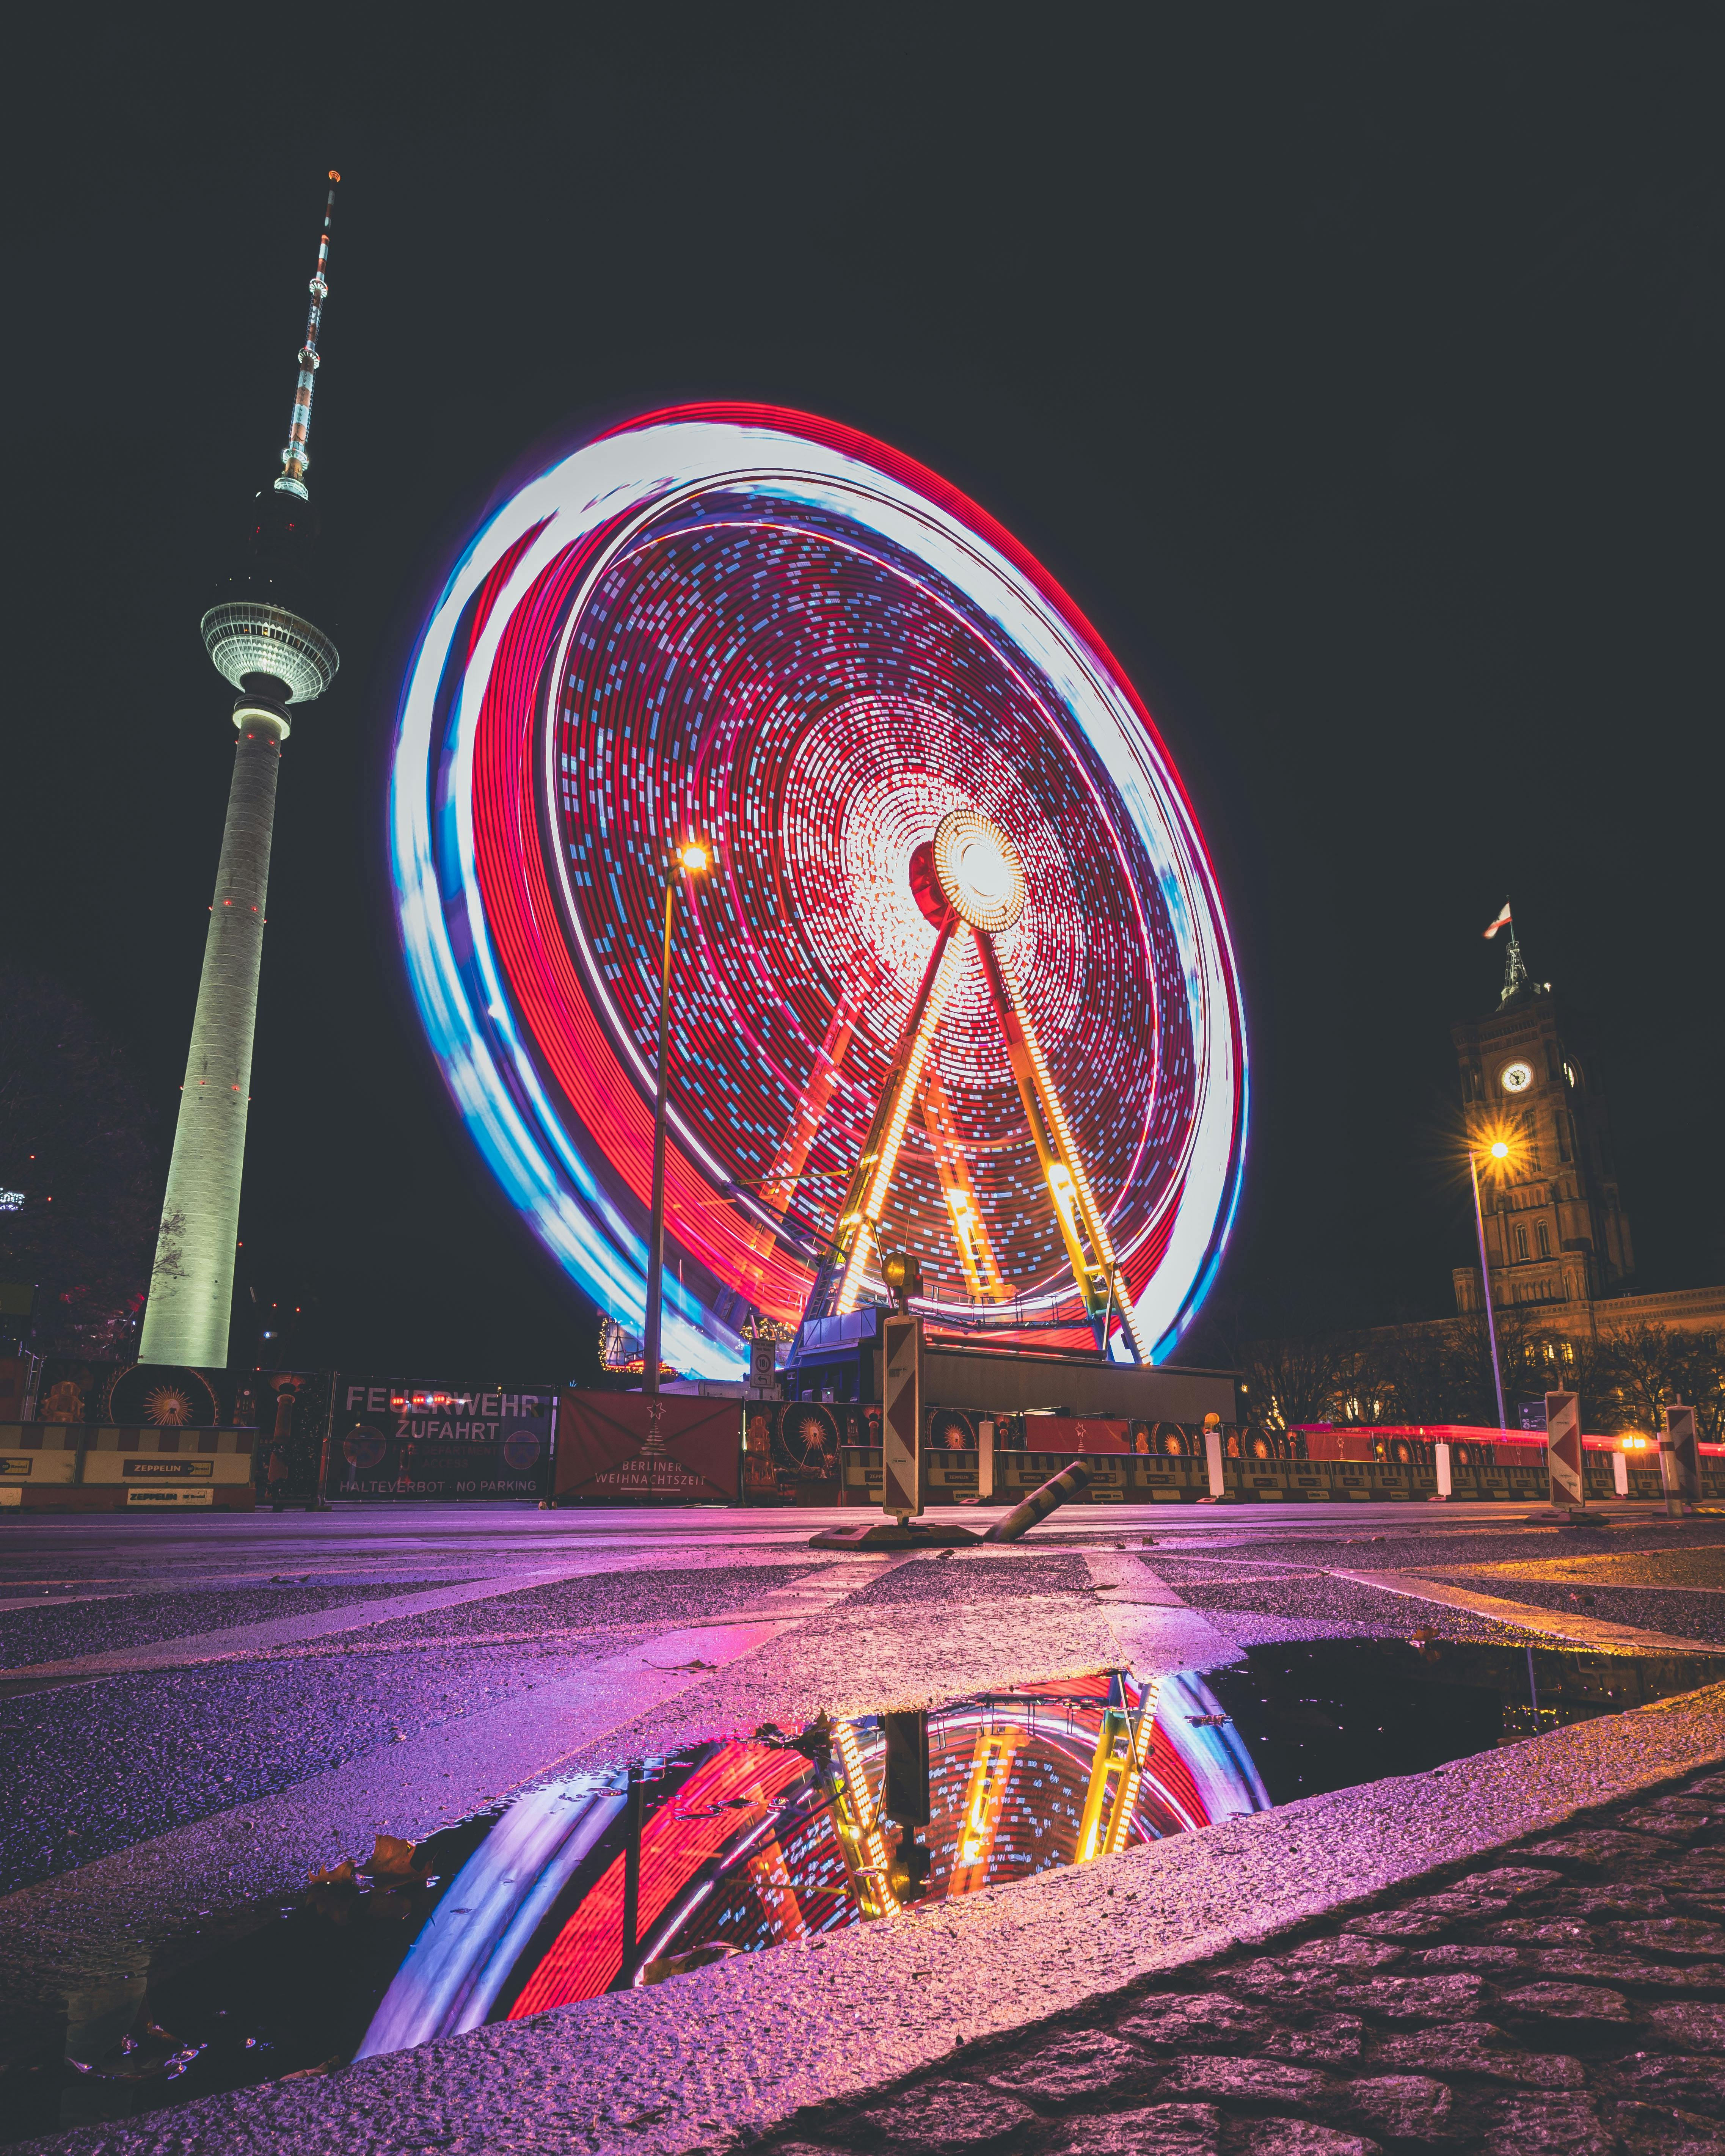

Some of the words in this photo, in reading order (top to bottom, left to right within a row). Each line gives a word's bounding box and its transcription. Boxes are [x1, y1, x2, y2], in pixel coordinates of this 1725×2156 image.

[346, 1386, 538, 1417] FEUERWEHR
[396, 1420, 499, 1439] ZUFAHRT
[422, 1459, 468, 1469] ACCESS
[622, 1461, 681, 1472] BERLINER
[595, 1473, 706, 1485] WEIHNACHTSZEIT
[340, 1481, 445, 1492] HALTEVERBOT
[457, 1481, 476, 1492] NO
[480, 1481, 536, 1492] PARKING
